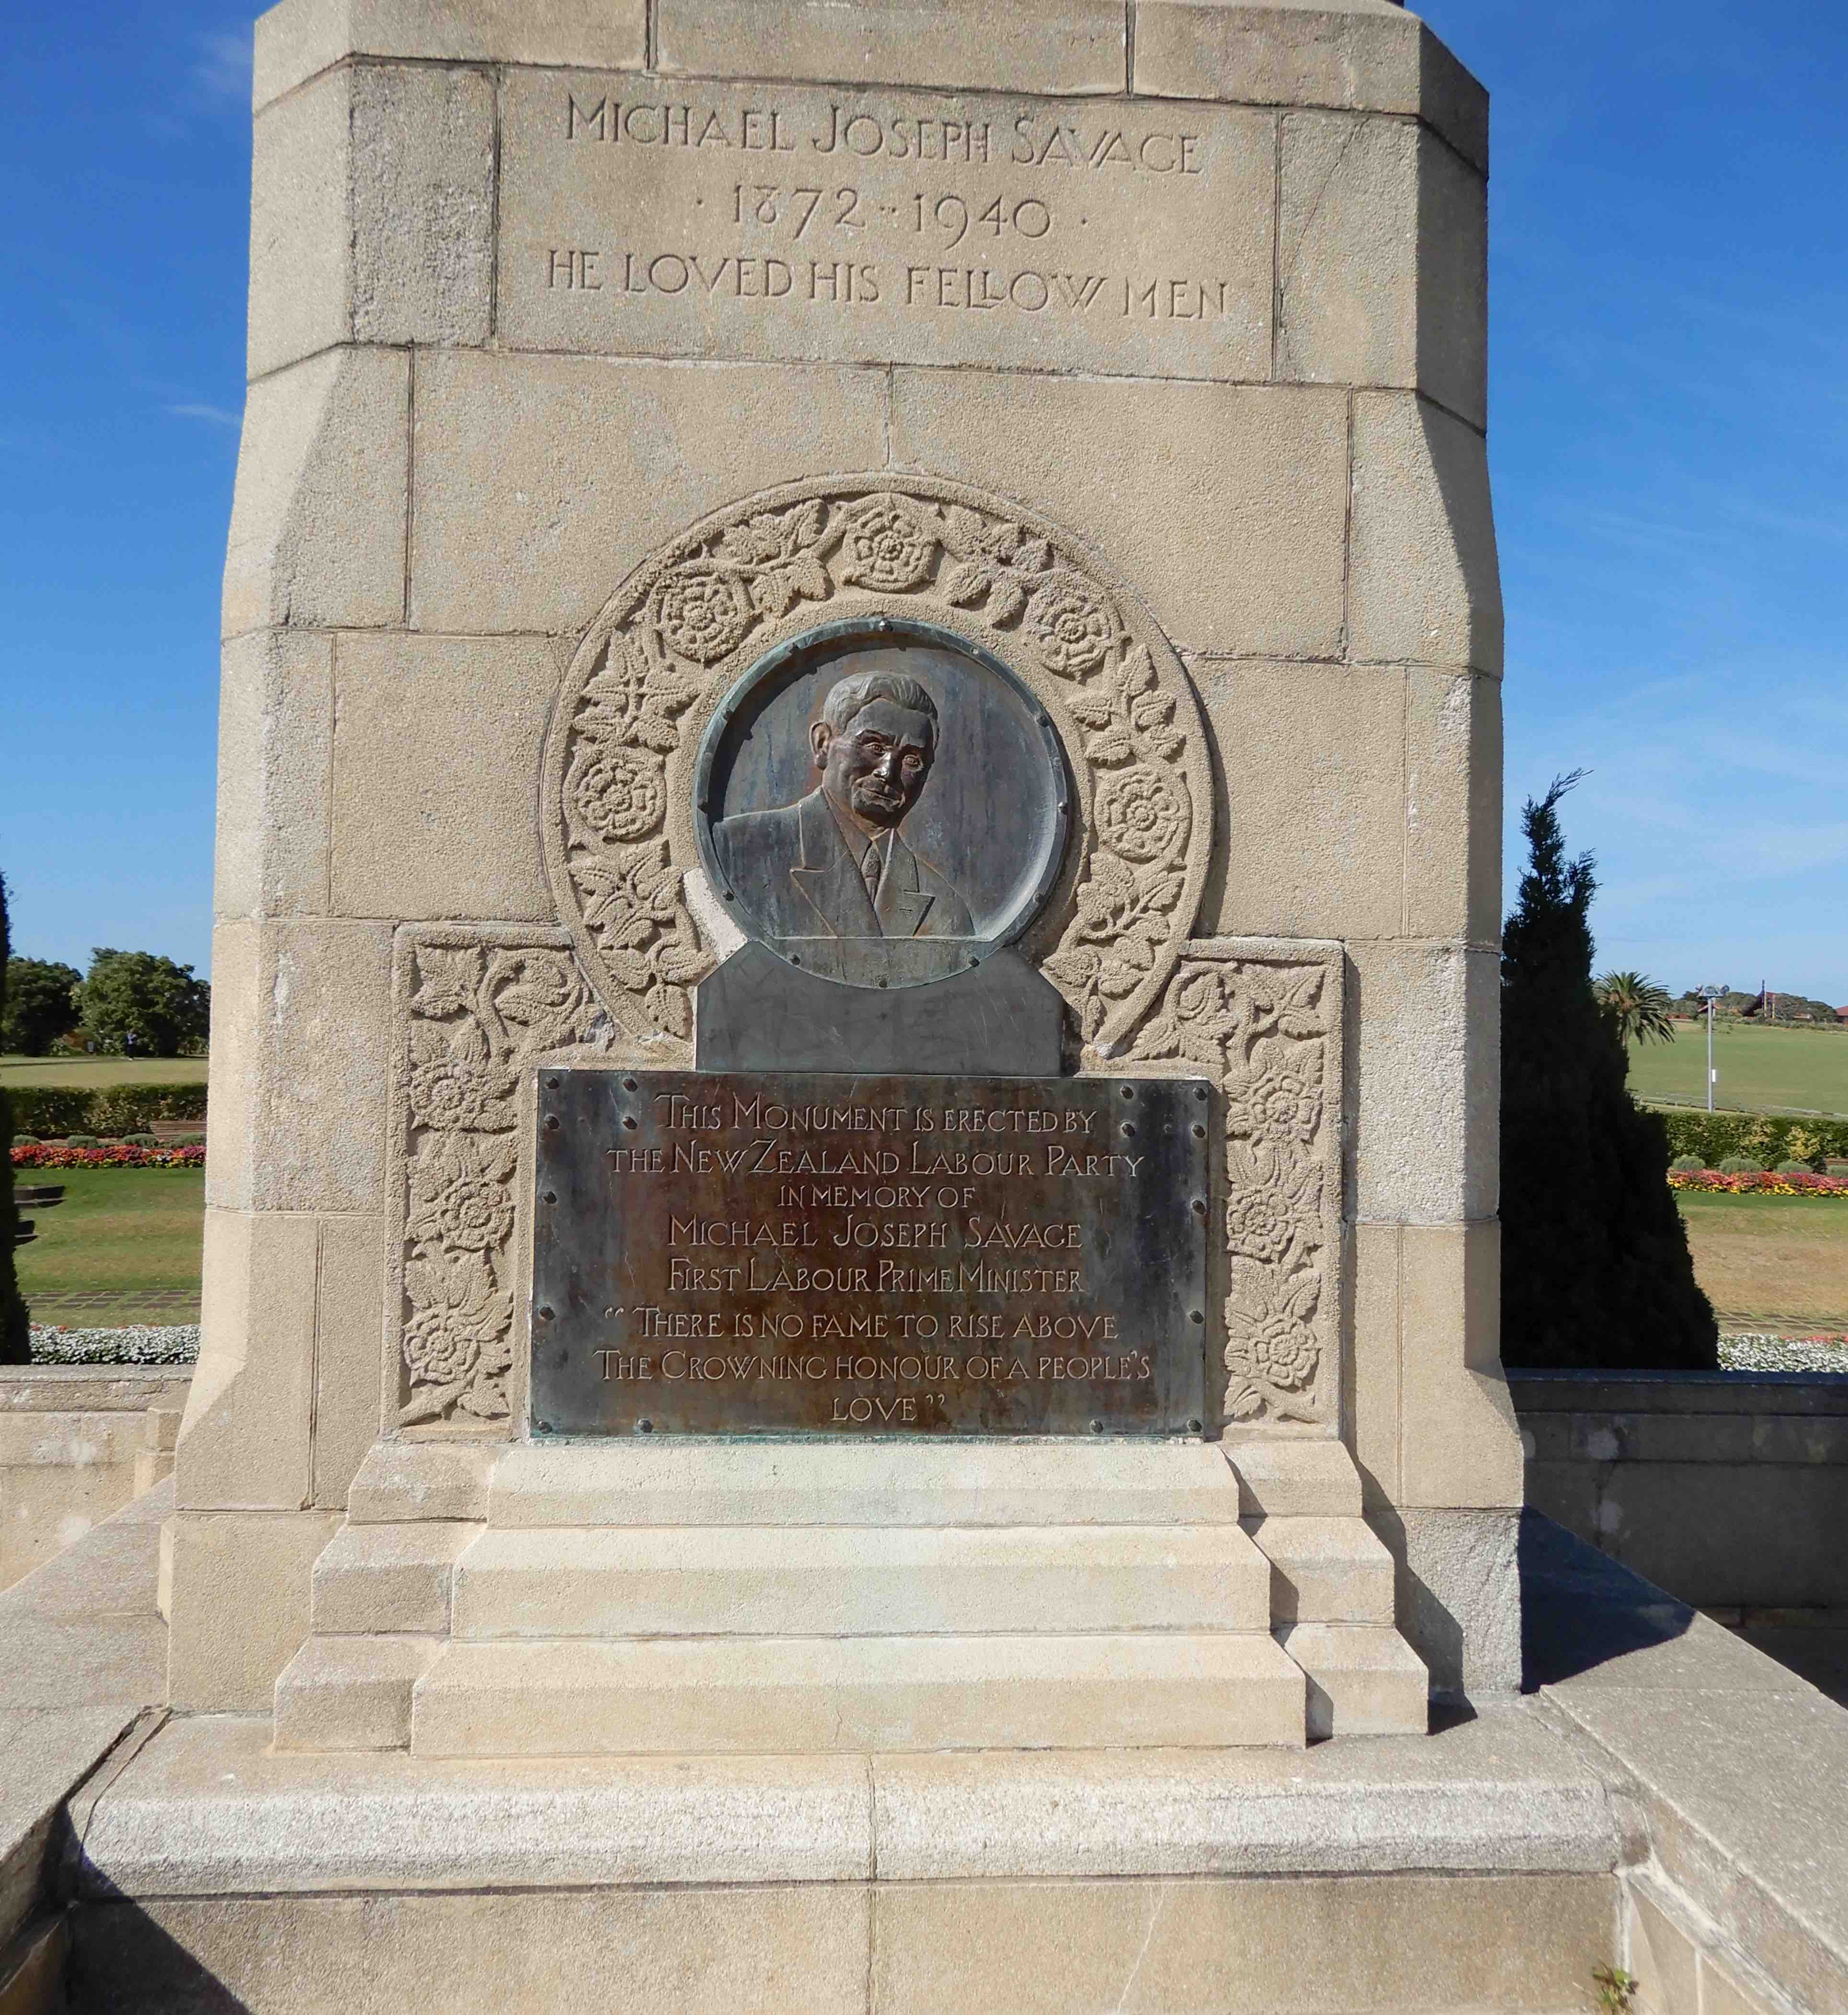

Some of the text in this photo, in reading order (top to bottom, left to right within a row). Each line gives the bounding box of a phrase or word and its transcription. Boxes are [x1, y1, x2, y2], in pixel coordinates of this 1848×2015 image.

[567, 93, 1202, 173] MICHAEL JOSEPH SAVAGE
[734, 185, 1051, 251] 1872 1940
[549, 250, 1227, 320] HE LOVED HIS FELLOW MEN
[654, 1091, 1097, 1134] THIS MONUMENT IS ERECTED BY
[606, 1139, 1145, 1177] THE NEW ZEALAND LABOUR PARTY
[777, 1184, 976, 1209] IN MEMORY OF
[667, 1213, 1083, 1248] MICHAEL JOSEPH SAVAGE
[667, 1257, 1085, 1293] FIRST LABOUR PRIME MINISTER
[732, 1313, 754, 1338] IS
[759, 1313, 804, 1338] NO
[811, 1314, 889, 1338] FAME
[895, 1314, 938, 1338] TO
[950, 1314, 1005, 1338] RISE
[1012, 1311, 1119, 1340] ABOVE
[592, 1350, 1150, 1381] THE CROWNING HONOUR OF A PEOPLE'S
